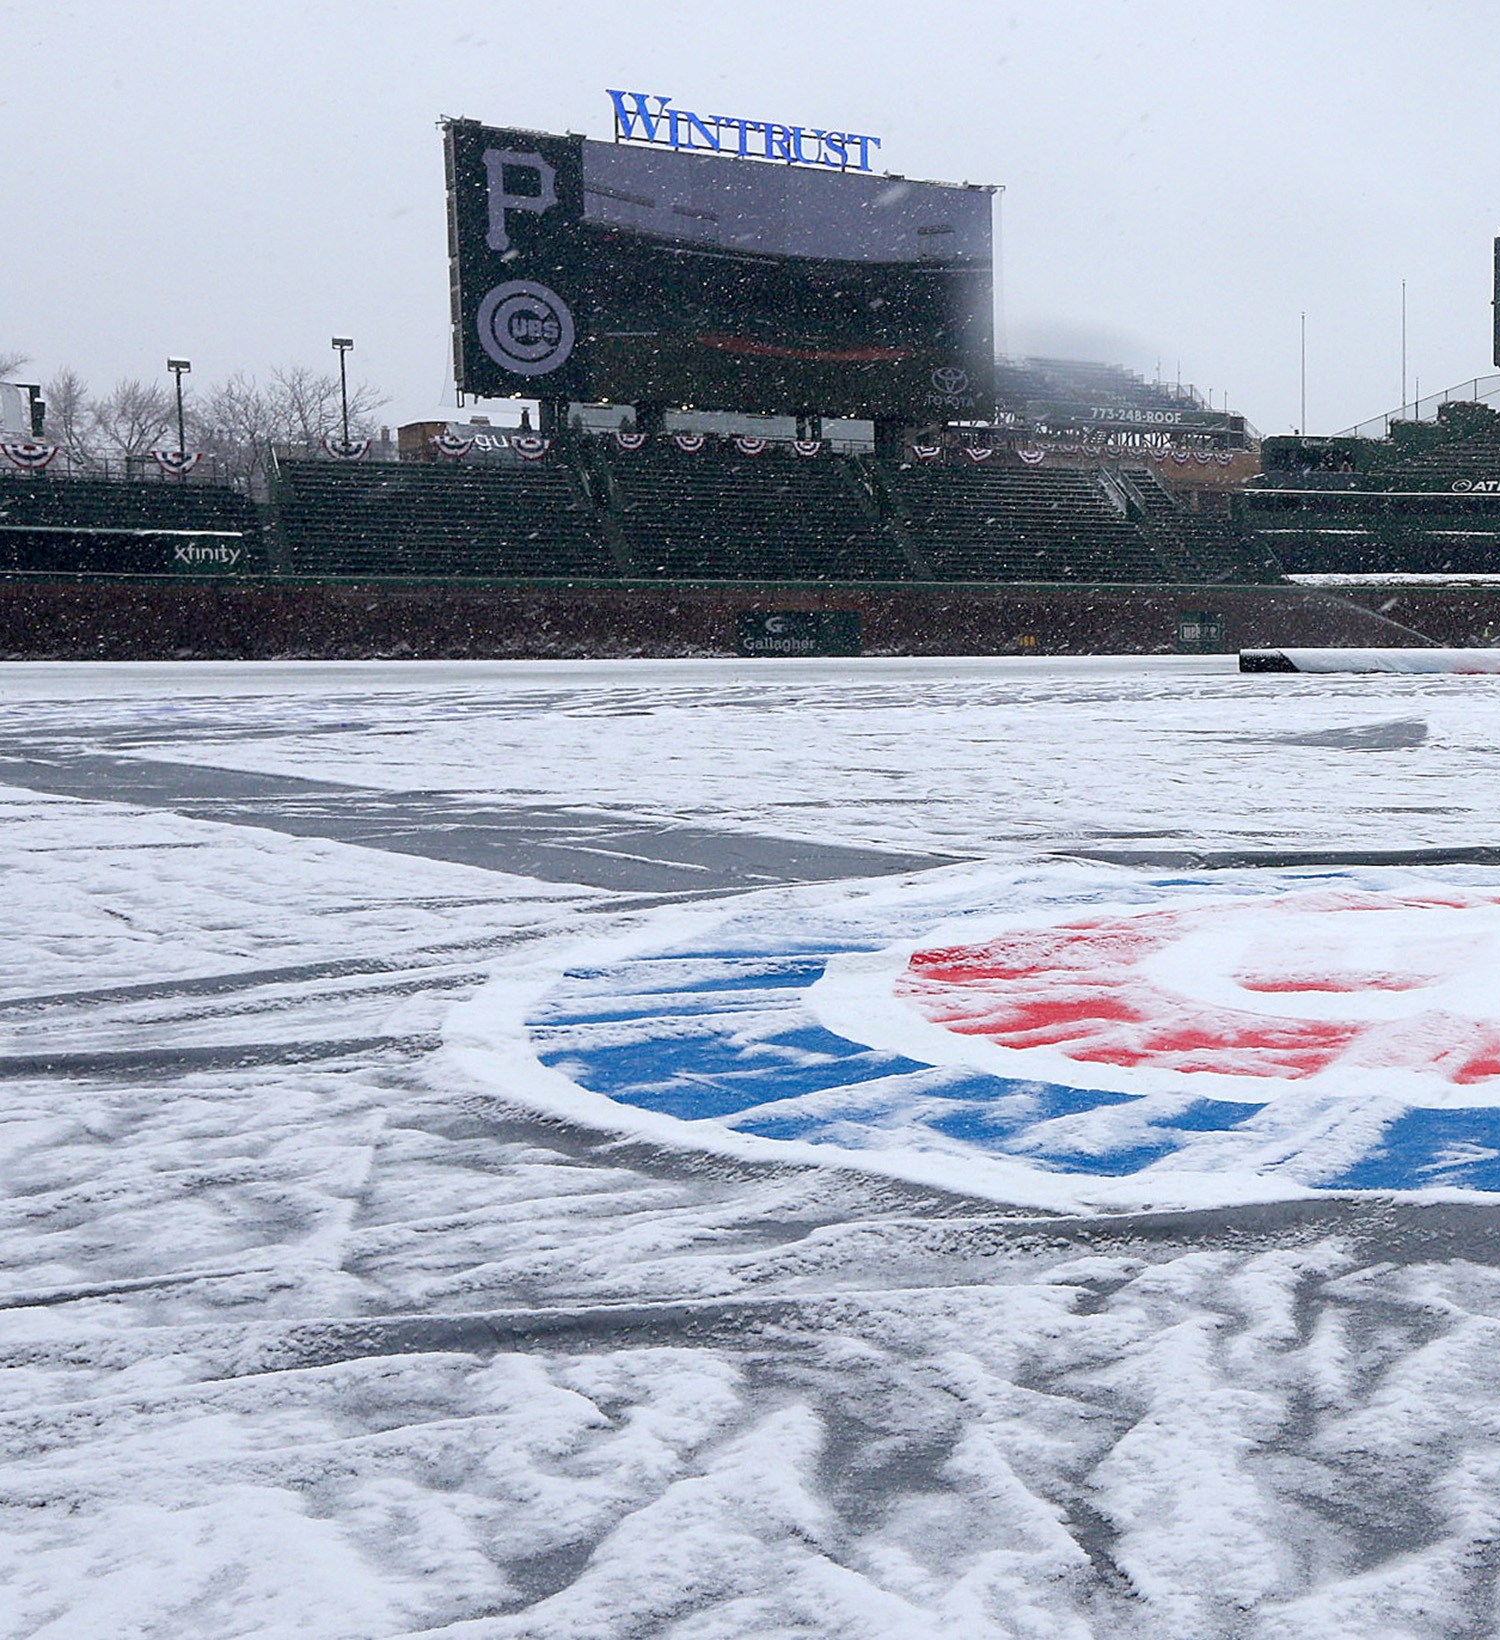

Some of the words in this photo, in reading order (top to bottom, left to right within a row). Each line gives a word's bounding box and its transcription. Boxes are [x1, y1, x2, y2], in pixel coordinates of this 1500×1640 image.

[606, 89, 881, 172] WINTRUST
[482, 150, 558, 250] P
[1090, 407, 1182, 424] 773-248-ROOF
[174, 542, 241, 565] xfinity
[743, 637, 816, 652] Gallagher
